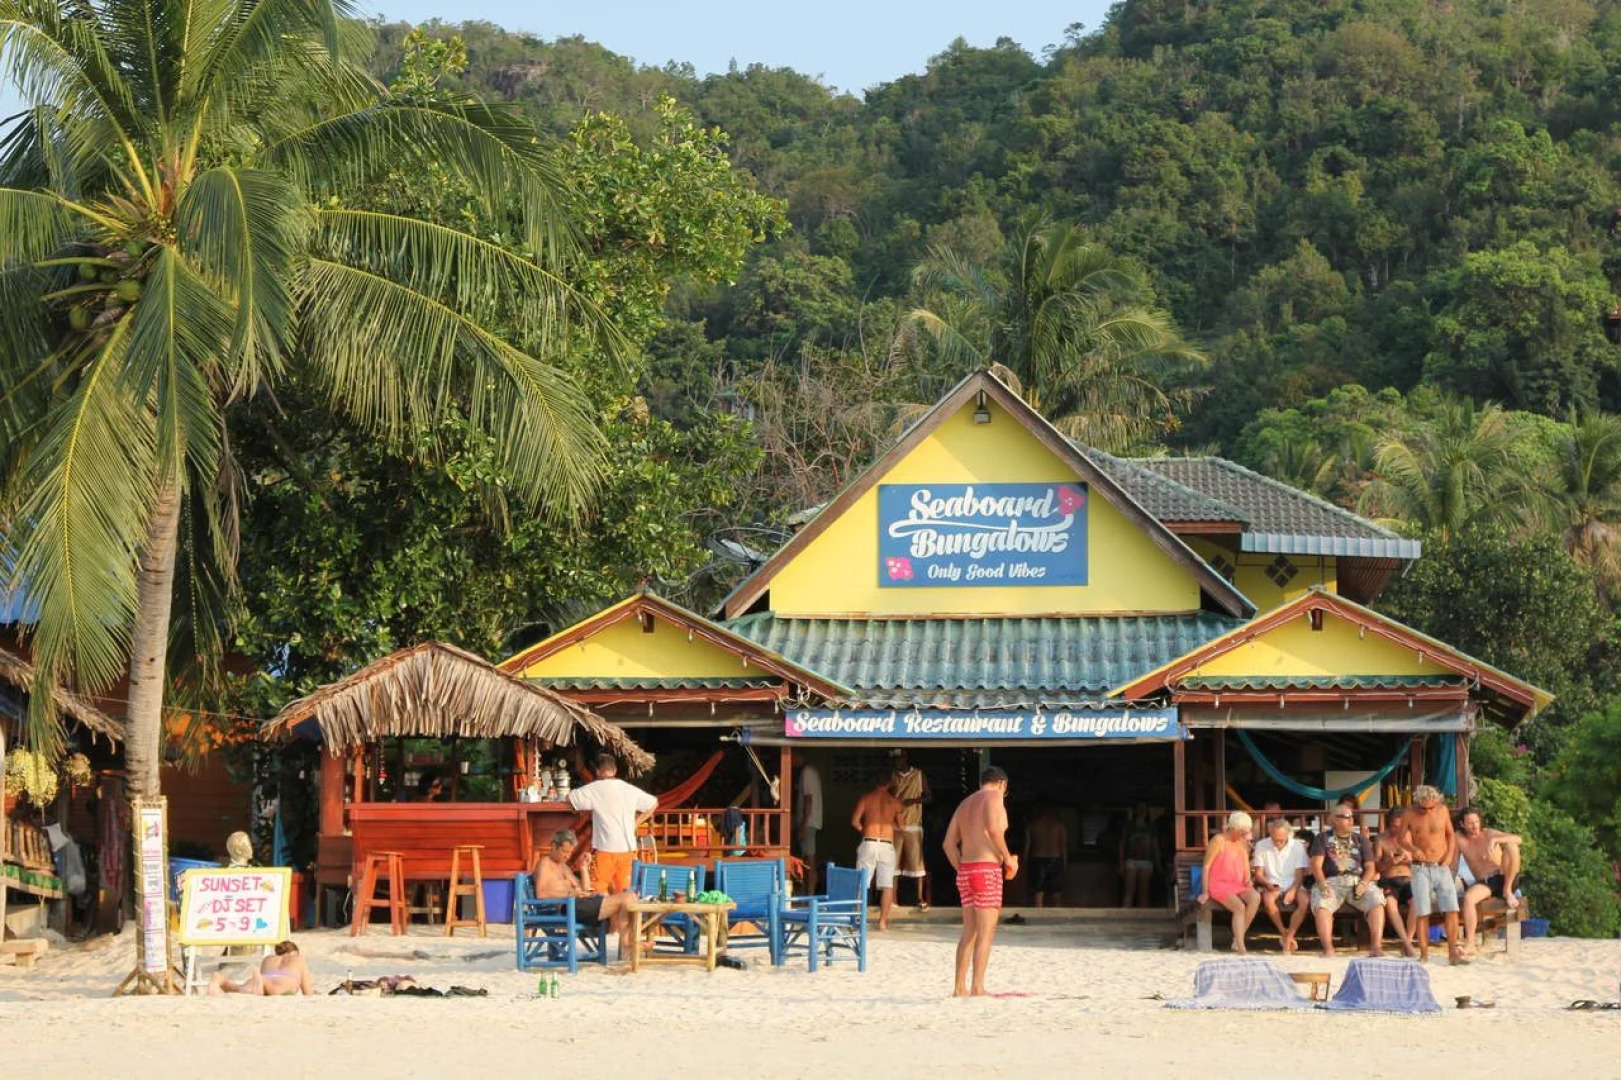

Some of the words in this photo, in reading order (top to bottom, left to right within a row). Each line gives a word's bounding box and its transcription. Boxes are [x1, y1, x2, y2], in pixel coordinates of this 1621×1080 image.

[908, 486, 1060, 521] Seaboard
[910, 520, 1069, 559] Bungalows
[927, 562, 962, 581] Only
[966, 563, 1004, 581] Good
[1009, 562, 1046, 578] Vibes
[794, 711, 896, 733] Seaboard
[904, 713, 1022, 734] Restaurant
[1031, 712, 1047, 735] &
[1053, 711, 1168, 737] Bungalows
[199, 876, 262, 892] SUNSET
[212, 898, 233, 914] DJ
[234, 898, 267, 912] SET
